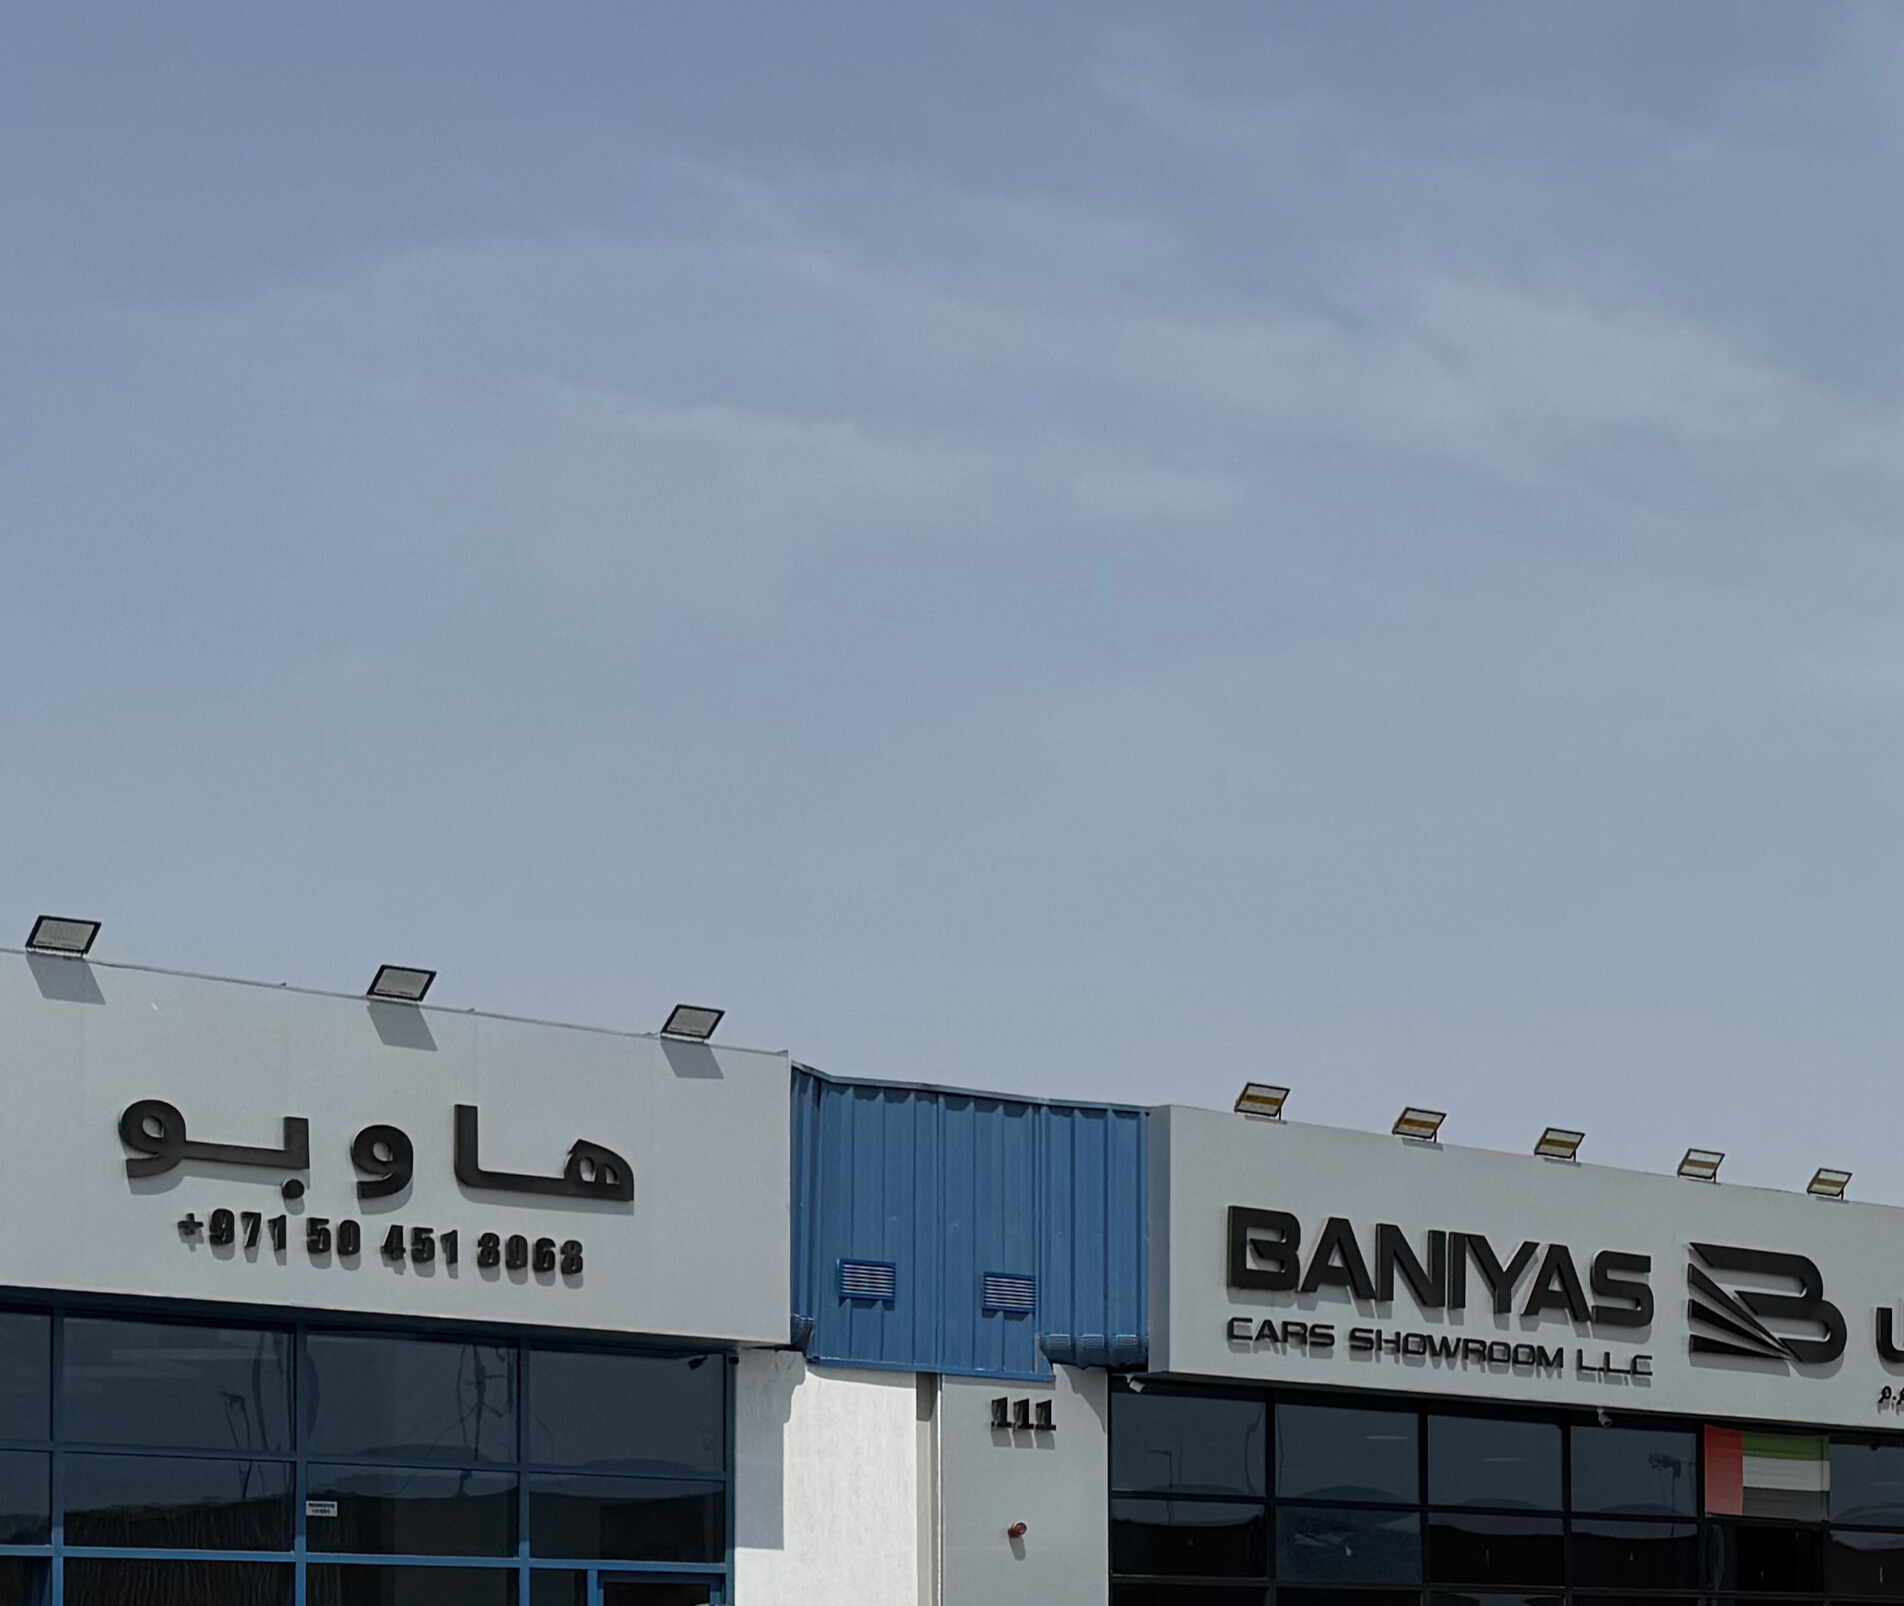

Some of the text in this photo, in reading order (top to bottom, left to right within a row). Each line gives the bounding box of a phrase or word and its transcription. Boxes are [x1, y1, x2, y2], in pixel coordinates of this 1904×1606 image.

[177, 1207, 288, 1251] +971
[305, 1216, 362, 1257] 50
[380, 1223, 460, 1266] 451
[1227, 1205, 1653, 1328] BANIYAS
[1227, 1316, 1336, 1347] CARS
[1348, 1327, 1564, 1370] SHOWROOM
[991, 1397, 1056, 1431] 111
